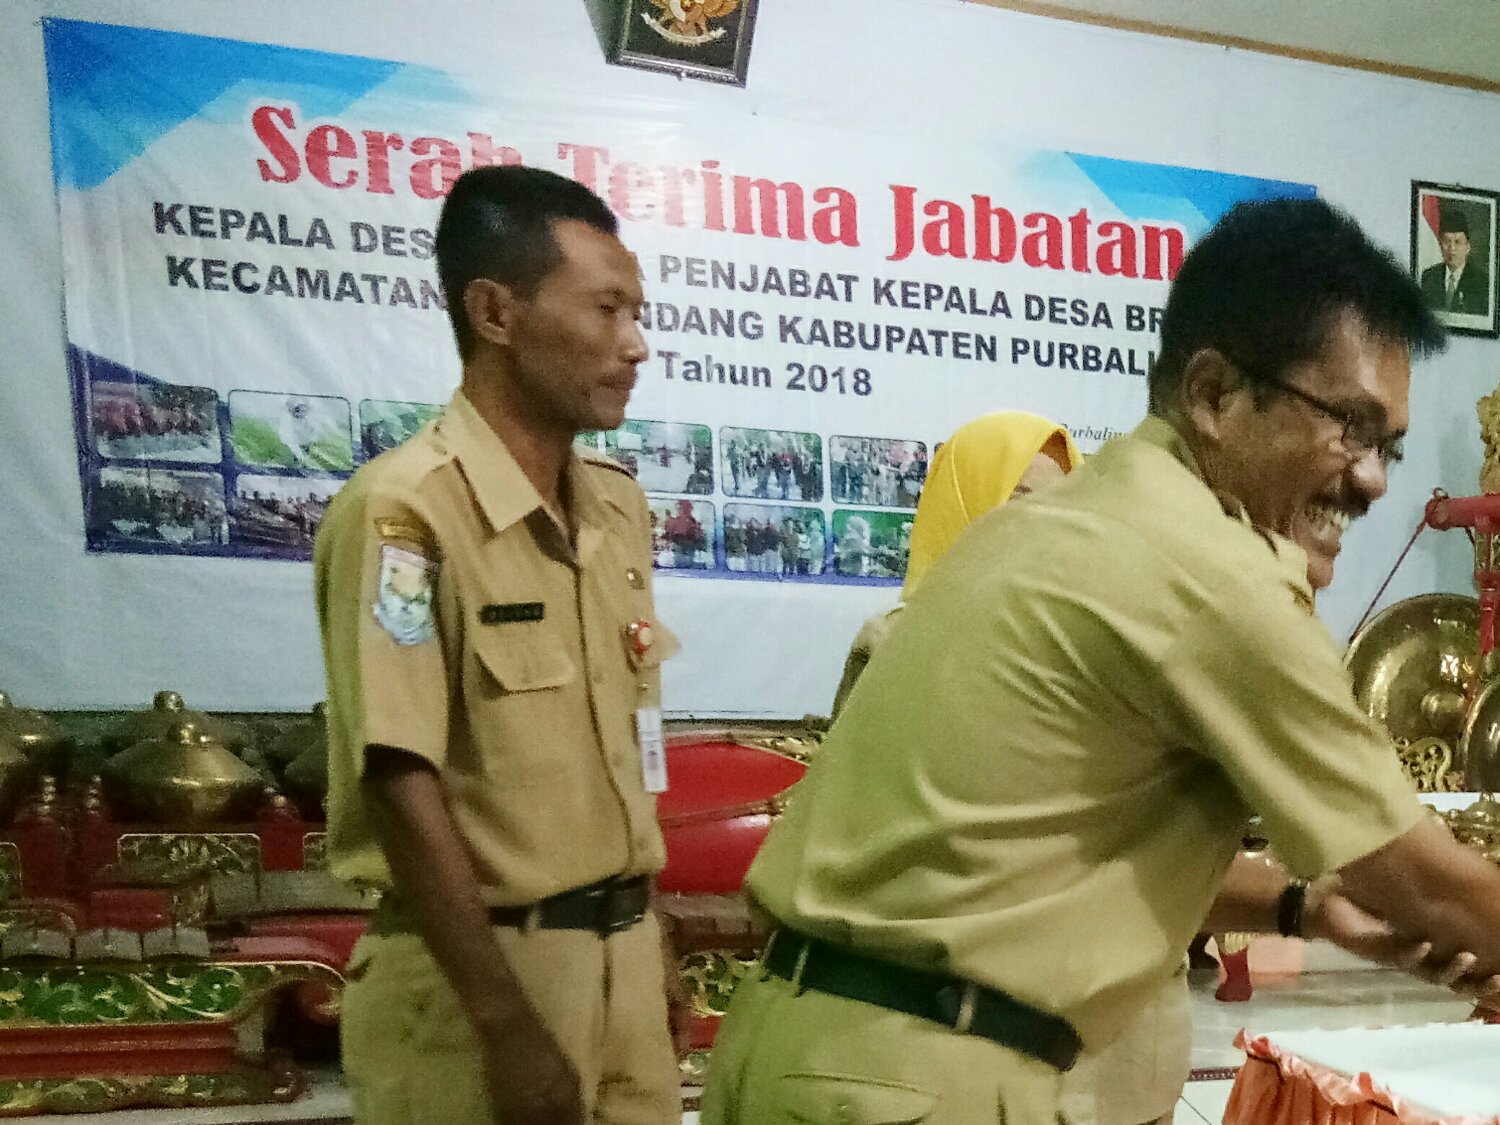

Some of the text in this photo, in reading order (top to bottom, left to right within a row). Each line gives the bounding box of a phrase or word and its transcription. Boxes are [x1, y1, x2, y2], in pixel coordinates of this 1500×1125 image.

[152, 201, 336, 251] KEPALA
[349, 221, 438, 260] DES
[659, 254, 860, 303] PENJABAT
[872, 277, 1013, 320] KEPALA
[1024, 293, 1114, 330] DESA
[1125, 304, 1166, 334] BR
[557, 142, 861, 248] Terima
[885, 184, 1186, 282] Jabatan
[165, 255, 449, 311] KECAMATAN
[778, 313, 998, 363] KABUPATEN
[656, 349, 873, 397] Tahun 2018
